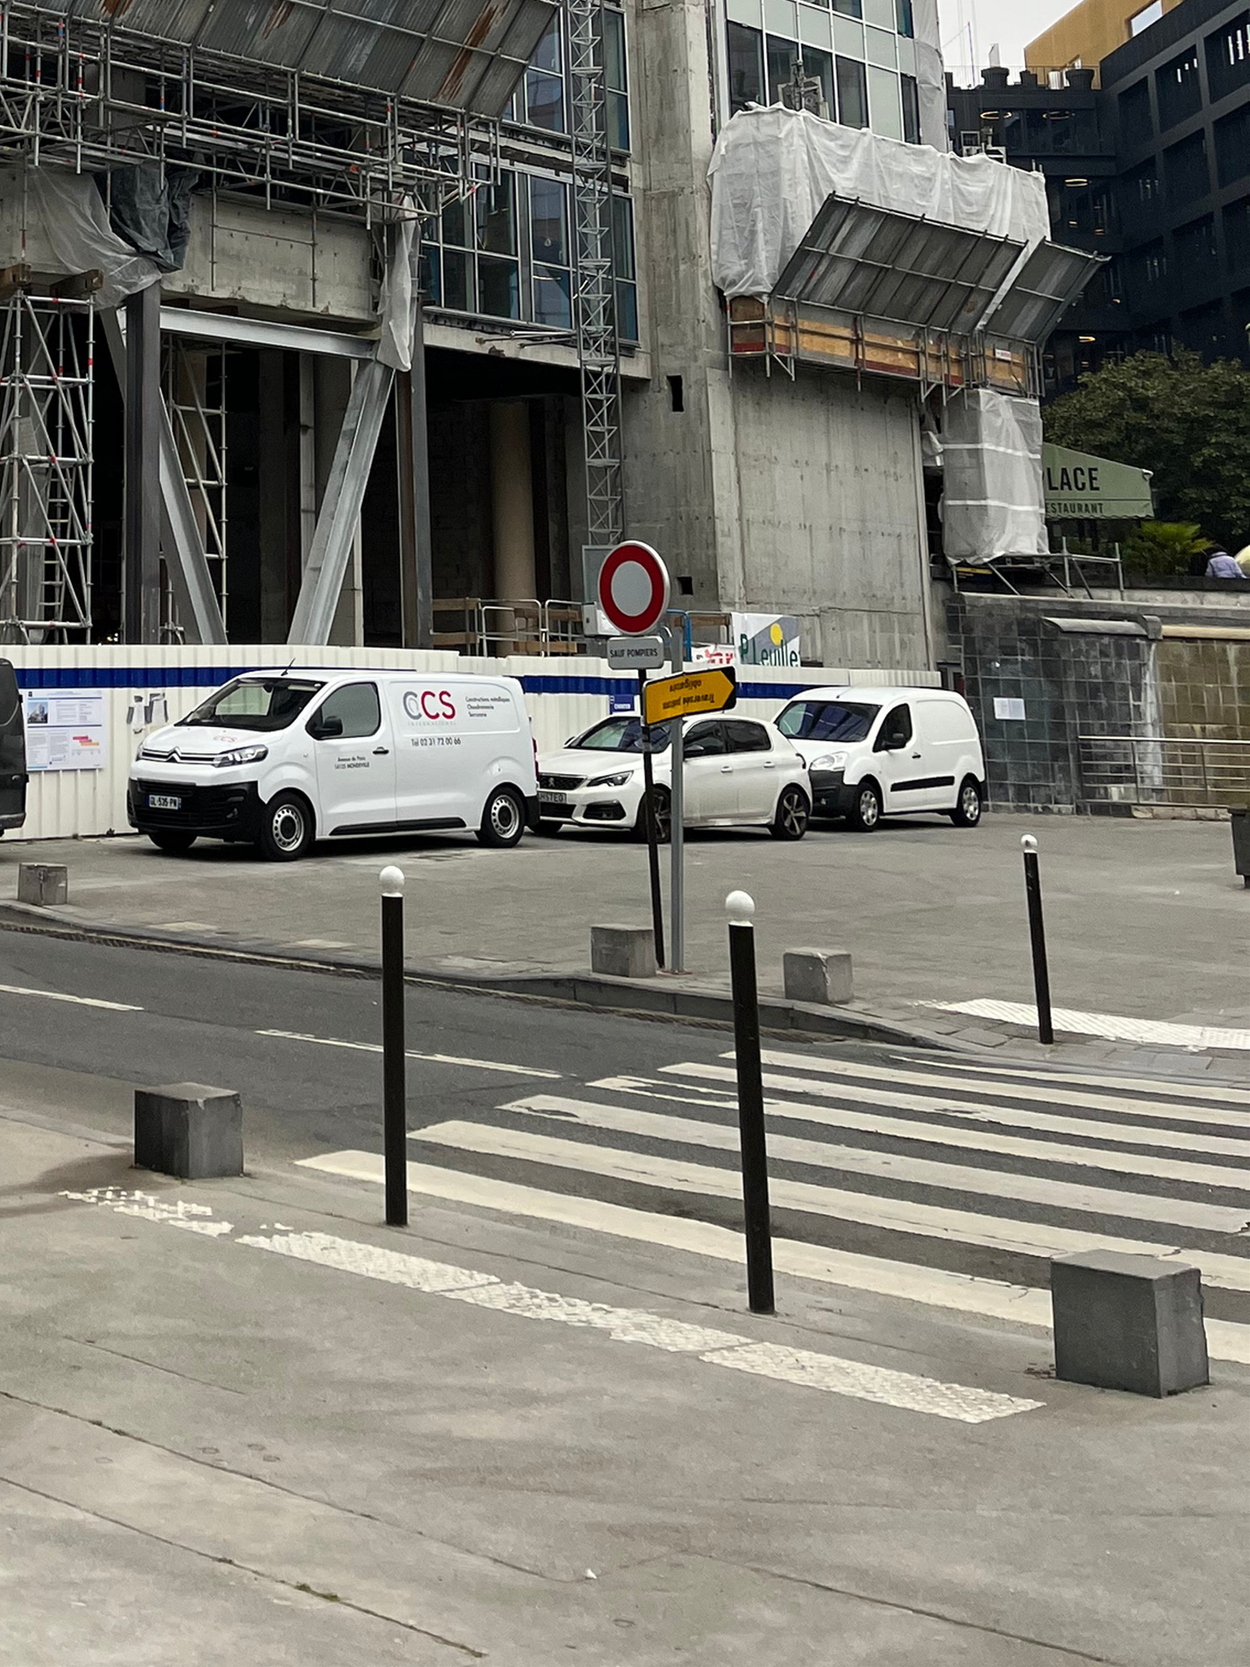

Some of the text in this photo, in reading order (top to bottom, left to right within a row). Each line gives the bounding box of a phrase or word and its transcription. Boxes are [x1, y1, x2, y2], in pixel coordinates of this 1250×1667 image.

[1043, 467, 1100, 491] LACE
[1044, 503, 1103, 514] ESTAURANT
[403, 690, 456, 720] CCS
